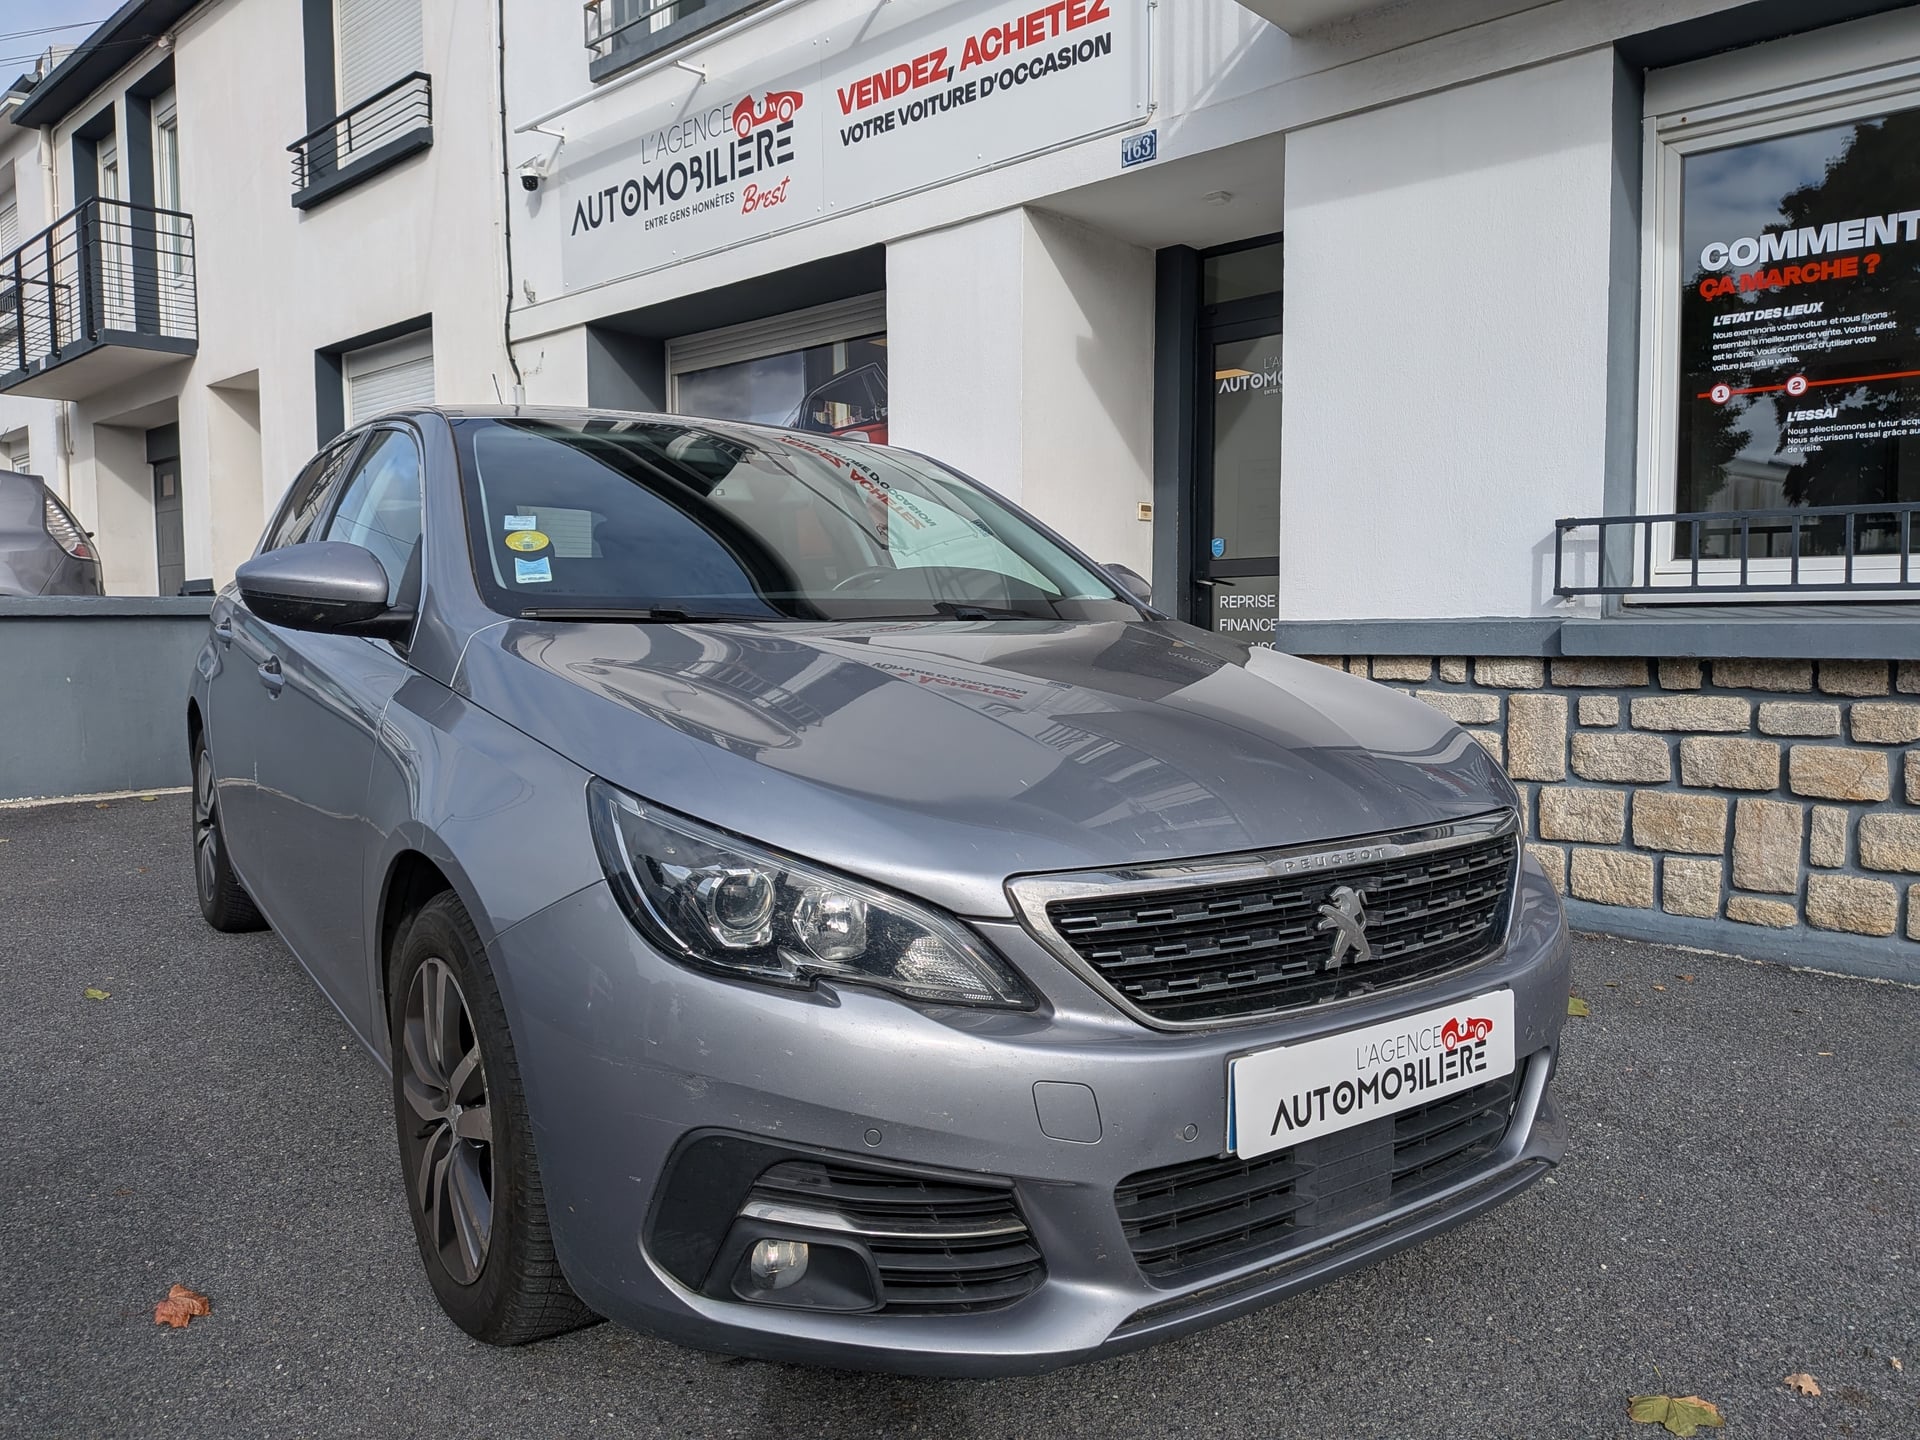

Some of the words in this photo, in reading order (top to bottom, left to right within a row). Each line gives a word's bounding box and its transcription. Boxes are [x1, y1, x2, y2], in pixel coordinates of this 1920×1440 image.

[837, 47, 954, 115] VENDEZ,
[960, 0, 1110, 72] ACHETEZ
[840, 111, 895, 146] VOTRE
[898, 82, 976, 126] VOITURE
[980, 32, 1112, 98] D'OCCASION
[641, 103, 733, 165] L'AGENCE
[1127, 137, 1150, 161] 163
[741, 176, 790, 215] Brest
[644, 216, 668, 231] ENTRE
[670, 207, 690, 223] GENS
[693, 191, 735, 214] HONNÊTES
[1700, 209, 1920, 272] COMMENT
[1700, 275, 1735, 302] ÇA
[1739, 256, 1859, 292] MARCHE
[1863, 253, 1881, 274] ?
[1713, 311, 1754, 326] L'ETAT
[1754, 307, 1782, 321] DES
[1783, 302, 1824, 317] LIEUX
[1713, 332, 1733, 340] Nous
[1734, 324, 1776, 337] examinons
[1777, 322, 1798, 331] votre
[1799, 319, 1827, 328] voiture
[1840, 315, 1860, 323] nous
[1861, 311, 1888, 321] fixons
[1713, 340, 1750, 350] ensemble
[1818, 328, 1842, 337] vente.
[1844, 325, 1867, 334] Votre
[1868, 321, 1897, 331] intérêt
[1712, 353, 1725, 361] est
[1757, 348, 1776, 356] Vous
[1777, 344, 1817, 353] continuez
[1818, 339, 1852, 348] d'utiliser
[1854, 336, 1876, 344] votre
[1264, 356, 1283, 369] L'A
[1712, 363, 1739, 371] voiture
[1775, 356, 1799, 365] vente.
[1787, 408, 1838, 422] L'ESSAI
[1810, 423, 1866, 433] sélectionnons
[1878, 420, 1899, 428] futur
[1800, 444, 1823, 452] visite.
[1810, 433, 1853, 443] sécurisons
[1855, 430, 1880, 438] l'essai
[1882, 428, 1907, 438] grâce
[1220, 594, 1275, 608] REPRISE
[1220, 618, 1278, 632] FINANCE
[1285, 847, 1385, 873] PEUGEOT
[1356, 1025, 1442, 1071] L'AGENCE
